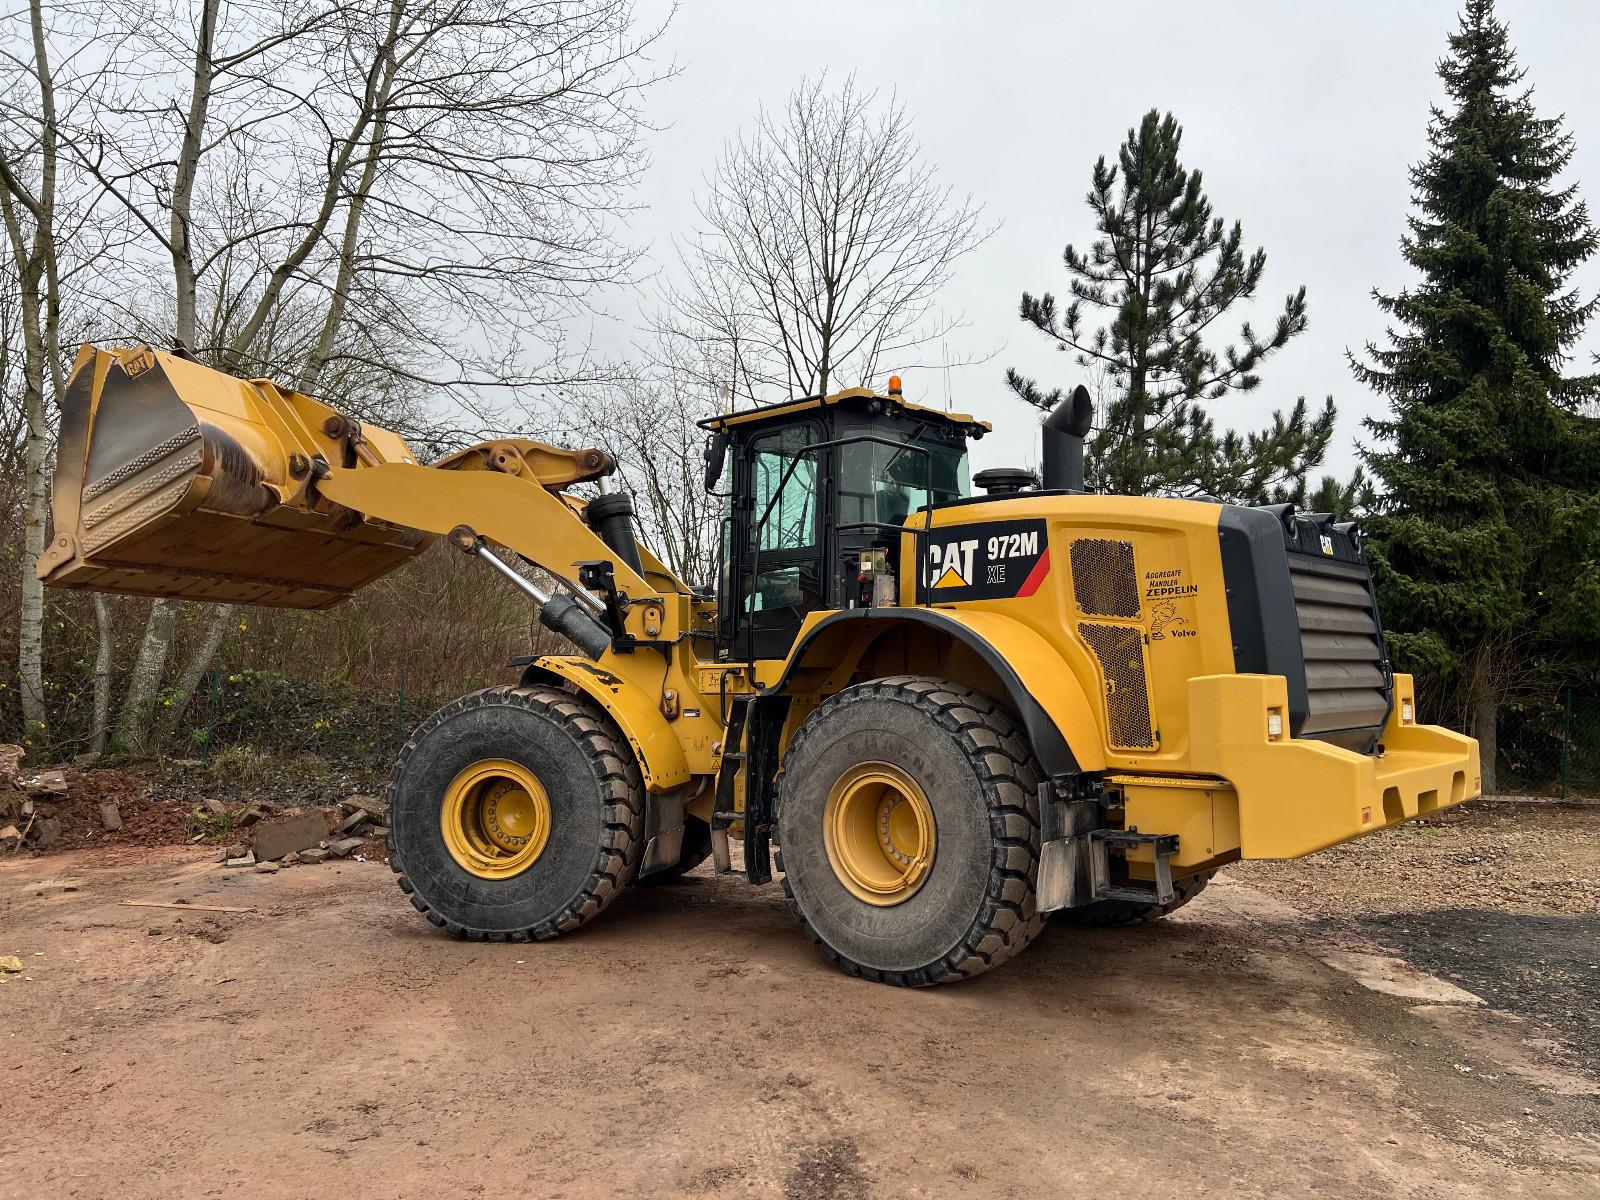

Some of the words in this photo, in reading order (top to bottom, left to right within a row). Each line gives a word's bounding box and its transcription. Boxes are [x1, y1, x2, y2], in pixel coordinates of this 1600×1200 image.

[127, 356, 146, 376] CAT
[987, 530, 1038, 561] 972M
[922, 539, 978, 588] CAT
[986, 564, 1006, 584] XE
[1145, 569, 1181, 579] AGGREGATE
[1146, 585, 1197, 597] ZEPPELIN
[1149, 579, 1178, 588] HANDLER
[1171, 629, 1197, 638] Volvo
